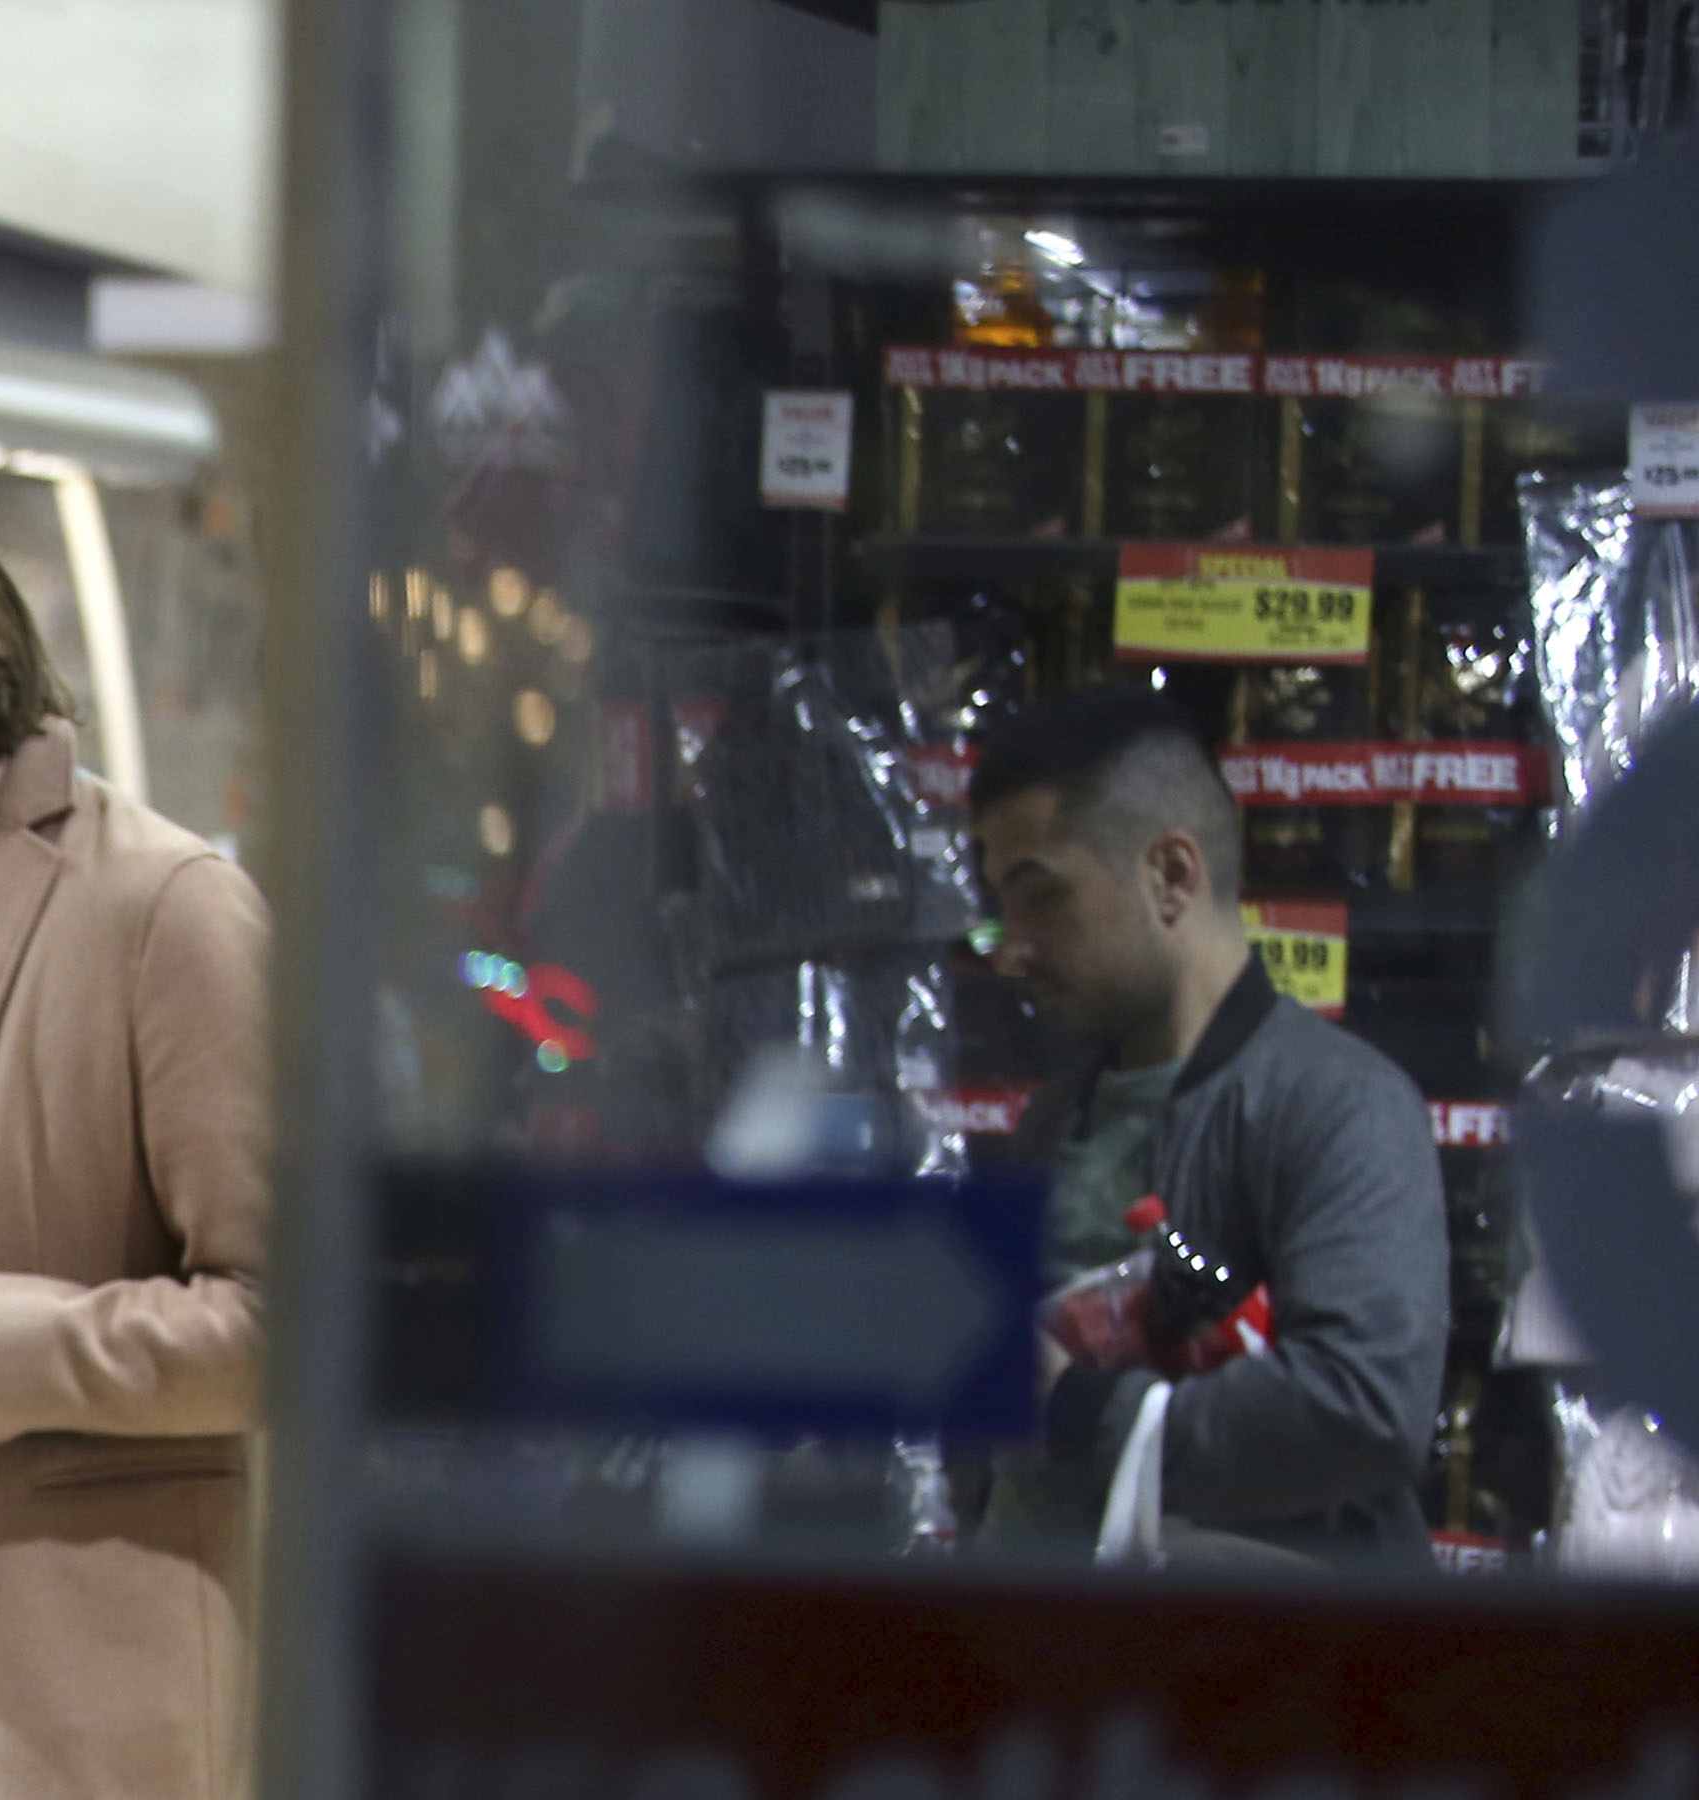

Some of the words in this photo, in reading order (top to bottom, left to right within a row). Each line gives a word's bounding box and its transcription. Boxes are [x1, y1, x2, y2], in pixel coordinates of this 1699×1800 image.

[988, 358, 1066, 387] PACK
[1122, 353, 1252, 392] FREE
[1255, 587, 1356, 624] $29.99
[1302, 762, 1368, 791] PACK
[1412, 753, 1519, 793] FREE
[1253, 938, 1328, 971] 9.99
